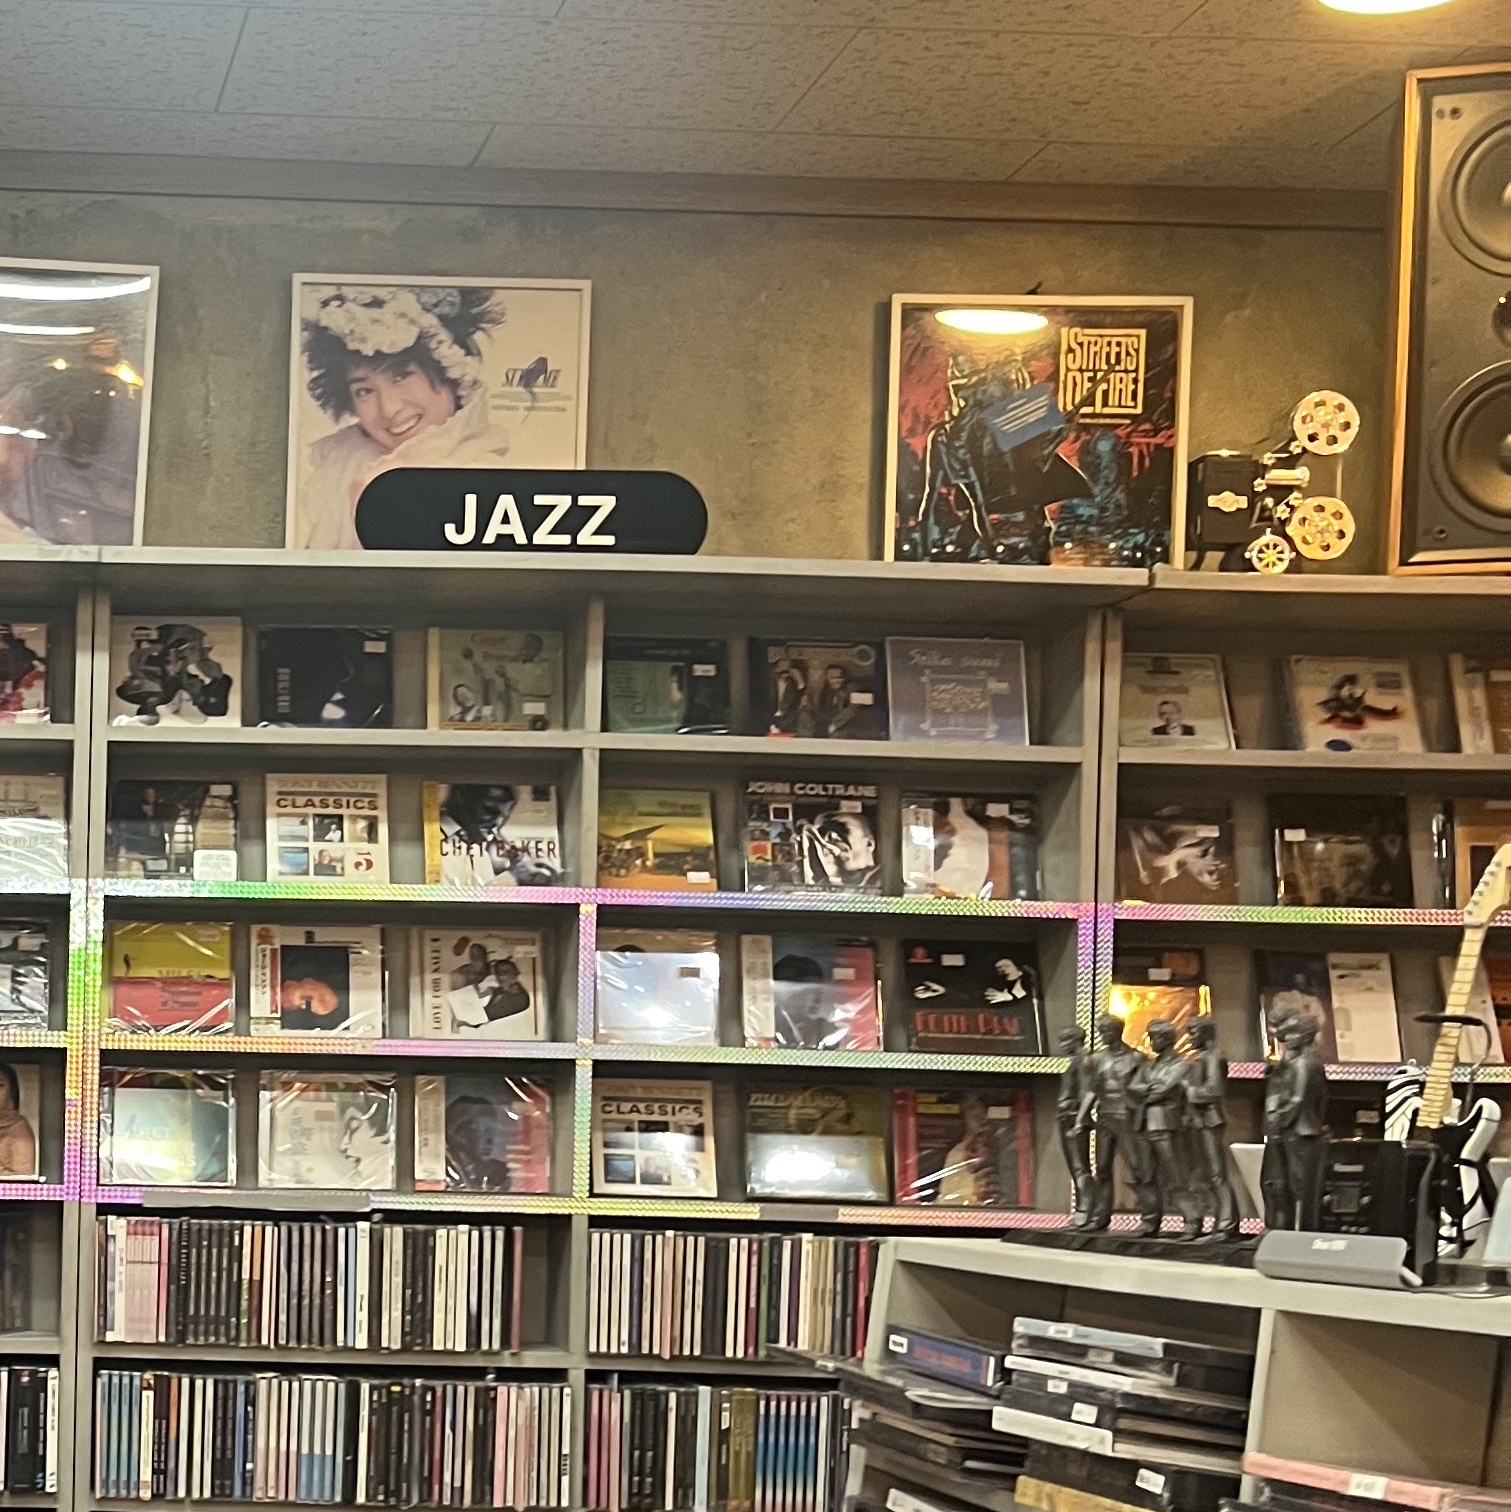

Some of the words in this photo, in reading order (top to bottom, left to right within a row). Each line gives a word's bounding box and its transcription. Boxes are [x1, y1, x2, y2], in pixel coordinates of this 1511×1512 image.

[1067, 327, 1139, 370] STREETS
[444, 494, 617, 546] JAZZ
[746, 781, 791, 795] JOHN
[793, 782, 878, 798] COLTRANE
[276, 798, 379, 811] CLASSICS
[439, 839, 484, 858] CHET
[496, 840, 557, 859] BAKER
